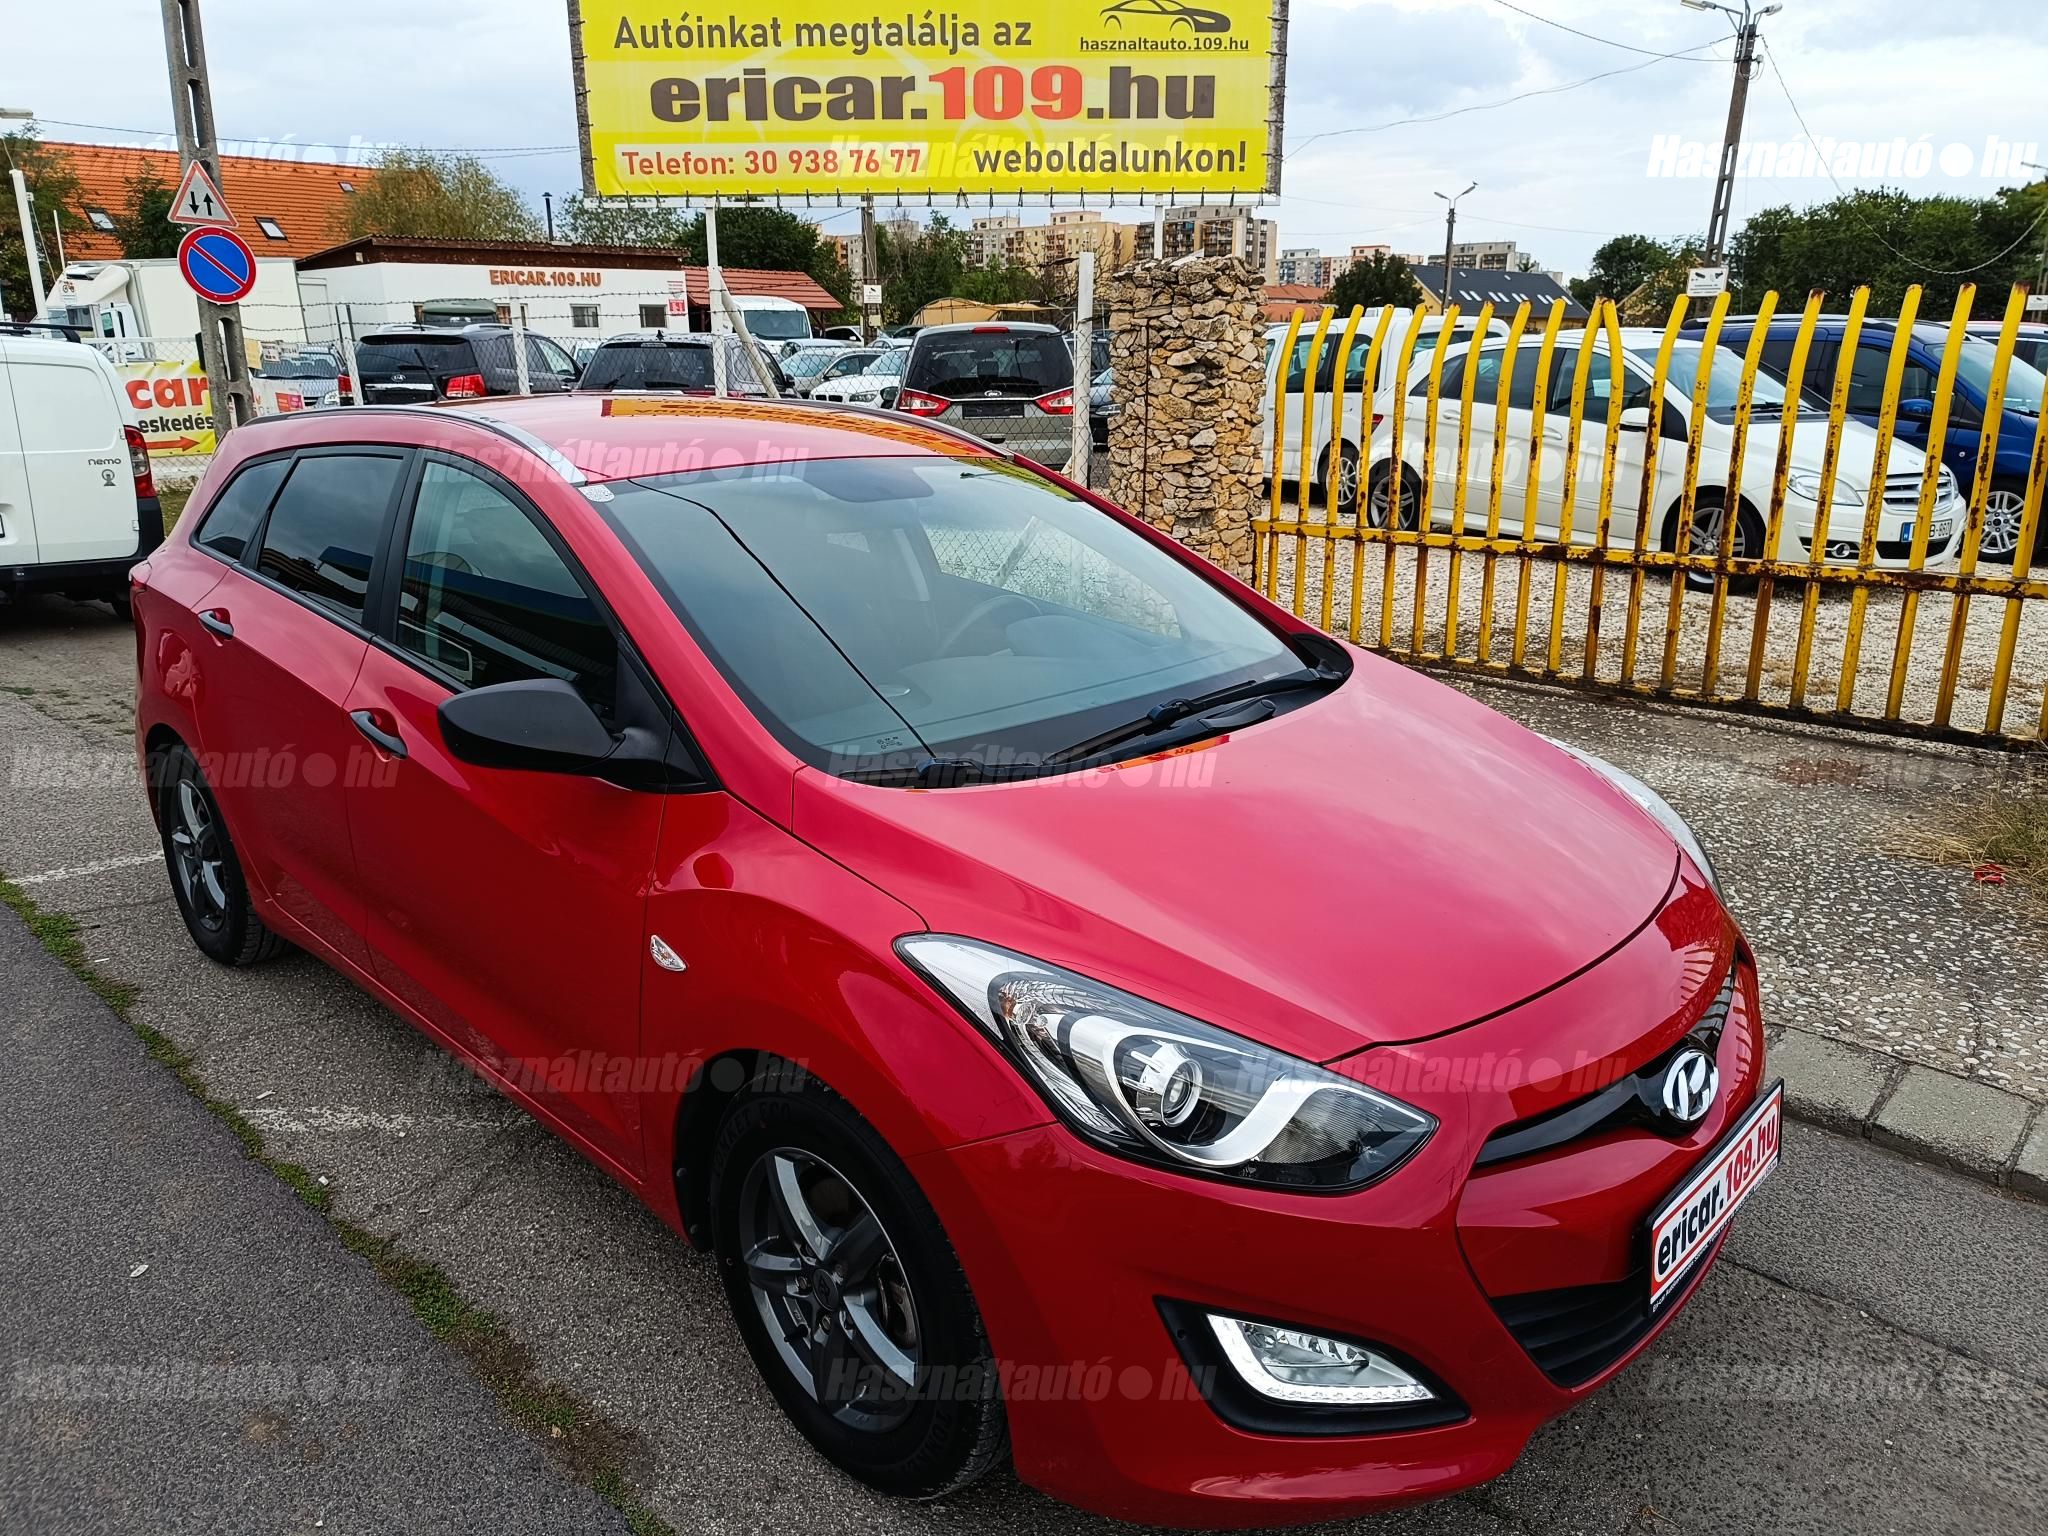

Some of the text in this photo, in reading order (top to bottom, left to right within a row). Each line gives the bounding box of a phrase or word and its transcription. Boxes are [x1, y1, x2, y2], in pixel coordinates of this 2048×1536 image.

[613, 9, 1032, 55] Autóinkat megtalálja az
[1080, 37, 1250, 51] hasznaltauto.109.hu
[649, 65, 1216, 123] ericar.109.hu
[622, 149, 921, 176] Telefon: 30 938 76 77
[973, 141, 1247, 173] weboldalunkon!
[489, 269, 601, 287] ERICAR.109.HU
[88, 458, 122, 466] nemo
[1657, 1114, 1776, 1276] ericar.109.hu
